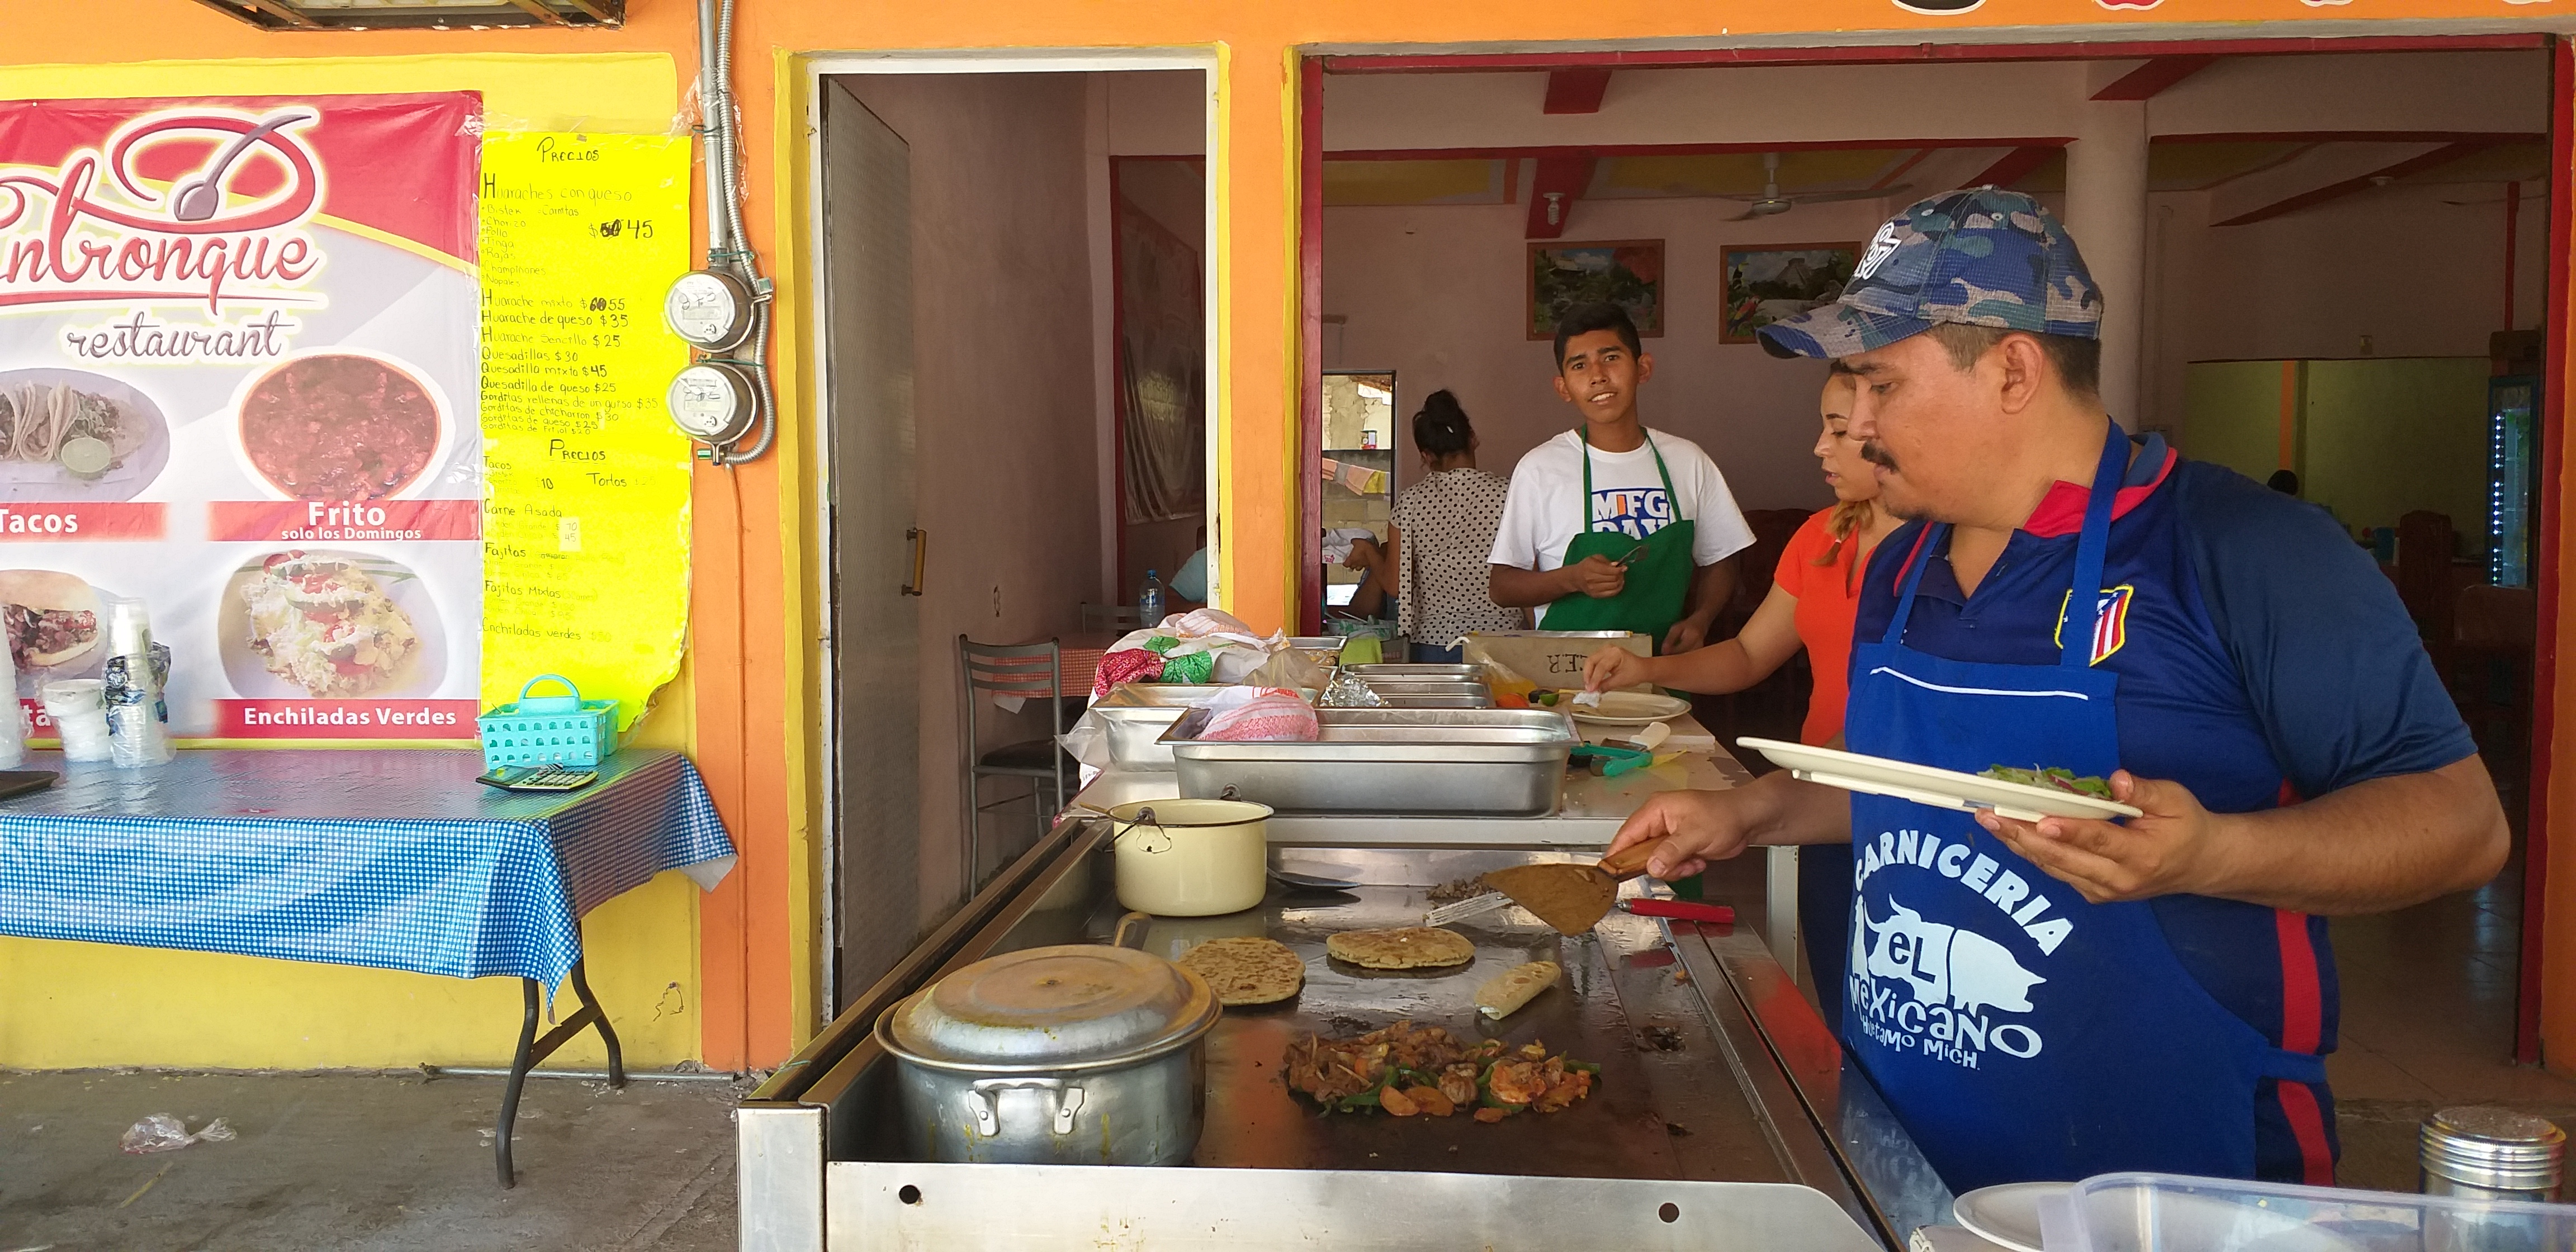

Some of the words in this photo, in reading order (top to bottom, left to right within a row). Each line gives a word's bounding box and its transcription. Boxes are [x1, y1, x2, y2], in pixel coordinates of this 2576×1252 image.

[484, 172, 553, 200] Huaraches
[561, 188, 585, 199] con
[589, 188, 632, 207] queso
[486, 217, 526, 228] Chorizo
[486, 226, 508, 238] Pollo
[485, 236, 515, 253] Tinga
[486, 247, 516, 262] Rajas
[486, 273, 520, 287] Nopales
[482, 288, 534, 307] Huarache
[541, 296, 572, 308] mixto
[482, 310, 536, 324] Huarache
[540, 311, 554, 324] de
[557, 316, 593, 329] queso
[67, 310, 295, 358] restaurant
[481, 326, 534, 343] Huarache
[482, 346, 551, 361] Quesadillas
[481, 362, 540, 374] Quesadilla
[481, 376, 537, 392] Quesadilla
[541, 381, 555, 392] de
[560, 385, 590, 396] queso
[481, 390, 523, 403] Gorditas
[527, 393, 570, 406] rellenas
[573, 396, 586, 408] de
[605, 400, 632, 413] guiso
[481, 402, 522, 414] Gorditas
[525, 404, 536, 415] de
[540, 407, 590, 420] chicharron
[481, 413, 524, 424] Gorditas
[527, 415, 538, 425] de
[543, 419, 570, 428] queso
[481, 422, 524, 431] Gorditas
[527, 424, 538, 433] de
[483, 456, 512, 470] Tacos
[586, 473, 627, 487] Tortas
[309, 501, 386, 526] Frito
[484, 499, 515, 516] Carne
[524, 504, 562, 518] Asada
[282, 527, 314, 539] solo
[319, 527, 340, 539] los
[344, 527, 422, 541] Domingos
[485, 542, 526, 559] Fajitas
[485, 580, 522, 597] Fajitas
[528, 586, 561, 599] Mixtas
[482, 617, 541, 637] Enchiladas
[547, 628, 581, 640] verdes
[244, 707, 370, 725] Enchiladas
[375, 707, 456, 725] Verdes
[1855, 829, 2073, 956] CARNICERIA
